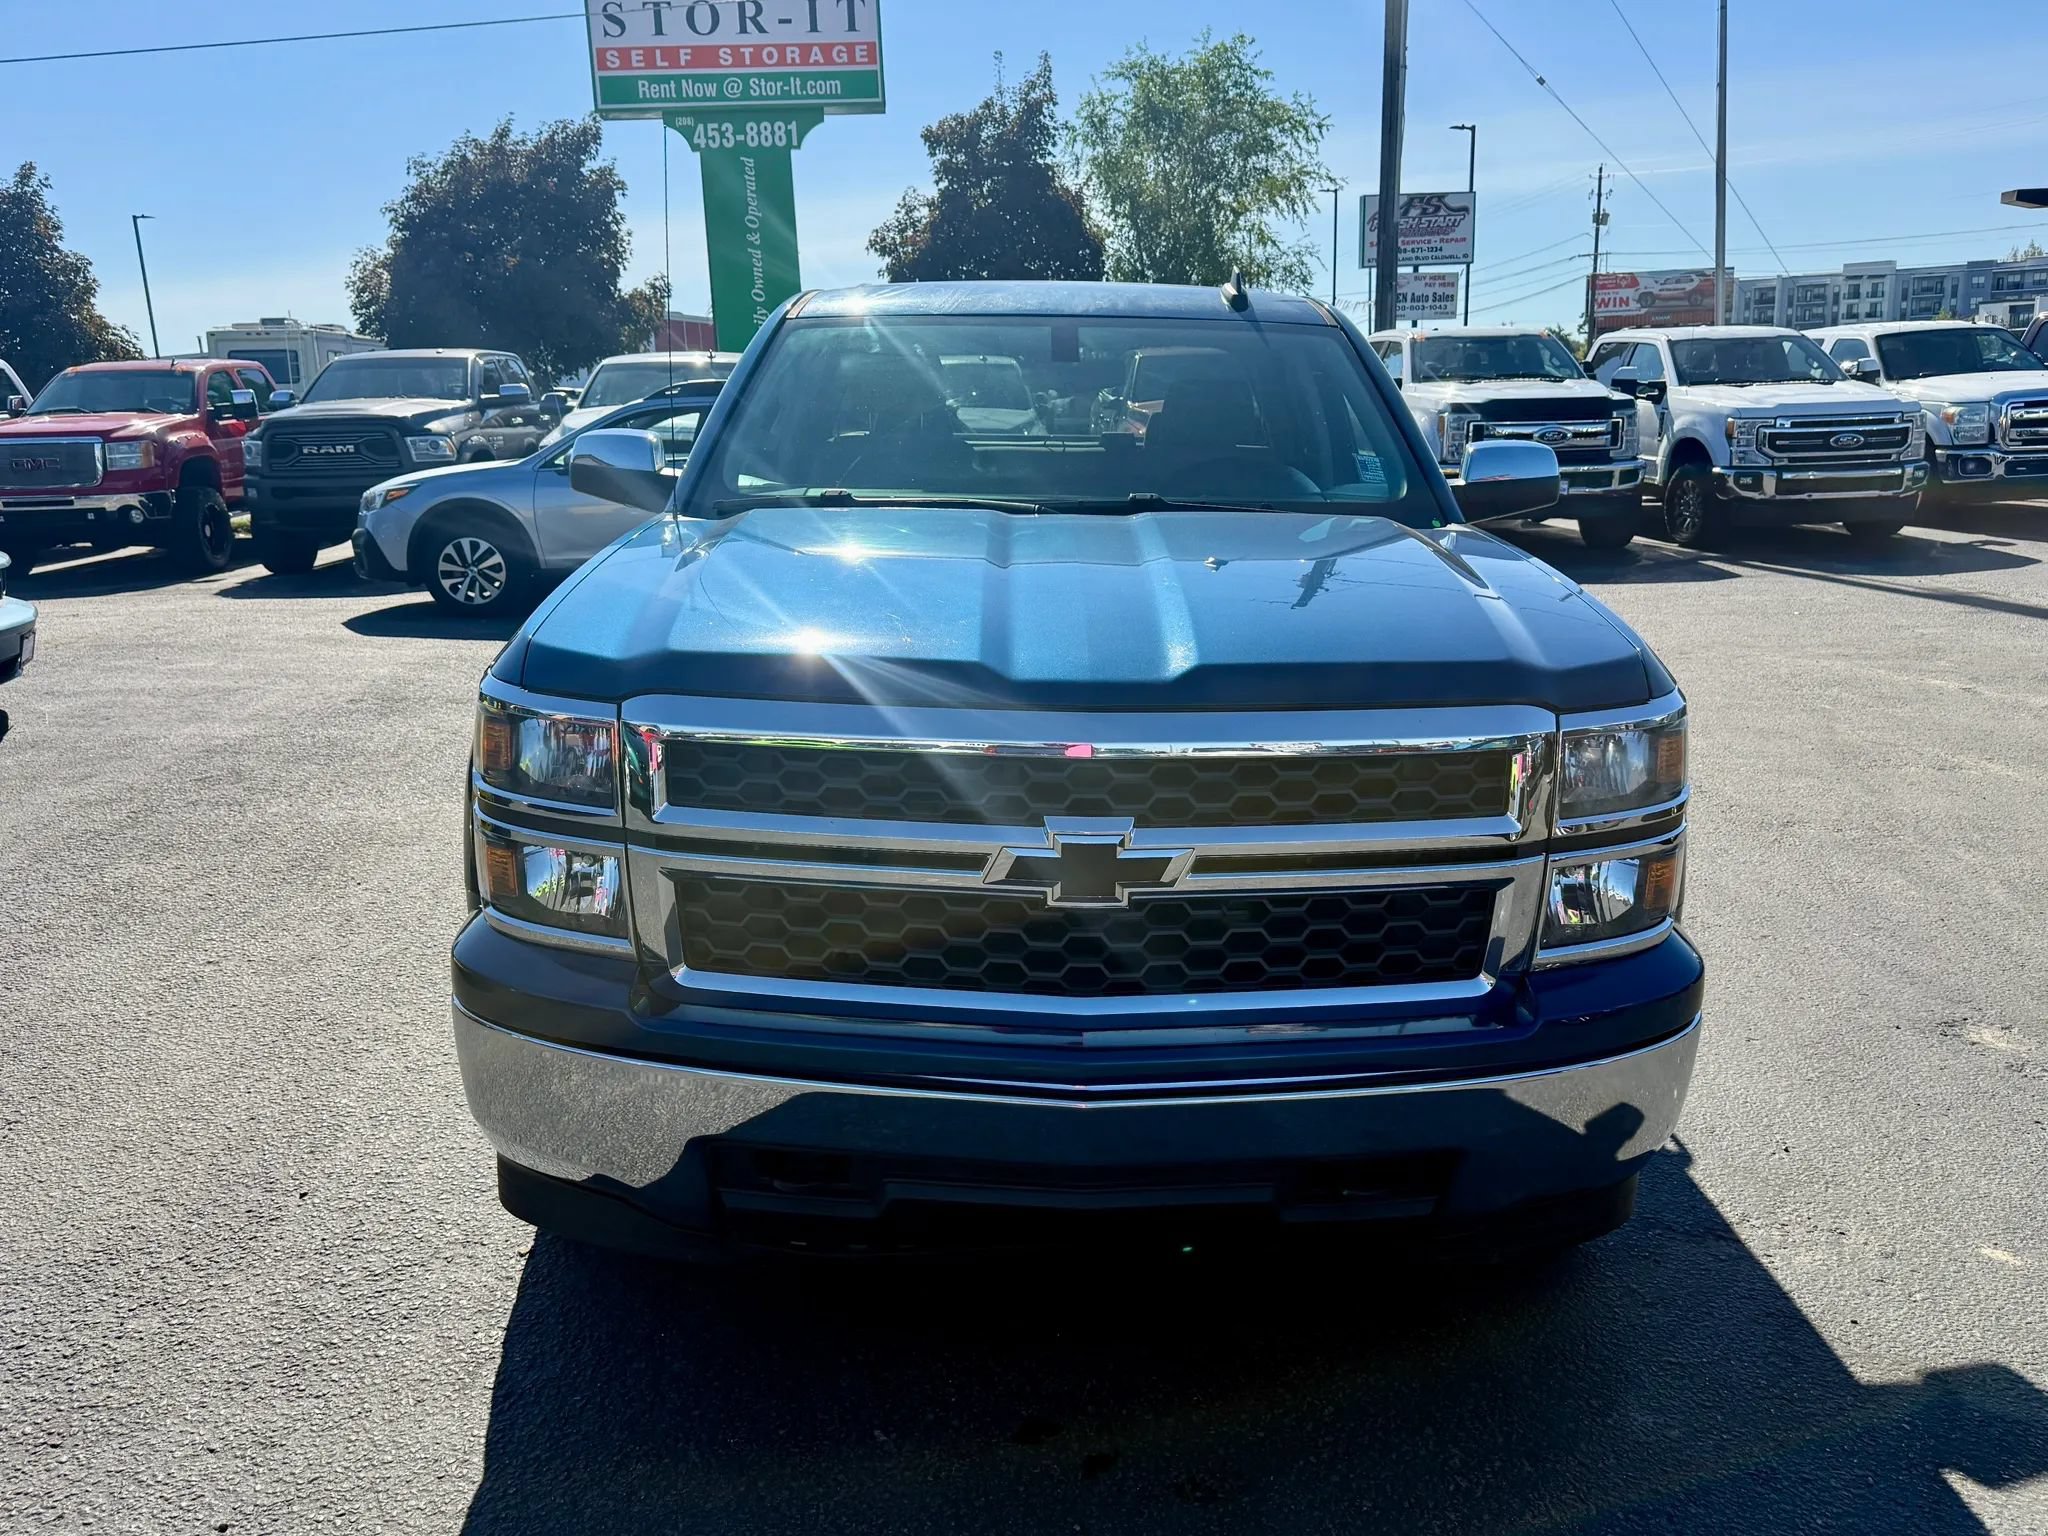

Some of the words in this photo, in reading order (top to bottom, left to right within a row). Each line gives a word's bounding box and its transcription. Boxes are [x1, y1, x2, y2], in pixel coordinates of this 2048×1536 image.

[601, 0, 866, 38] STOR-IT
[606, 49, 692, 68] SELF
[719, 45, 869, 64] STORAGE
[638, 80, 677, 98] Rent
[681, 79, 717, 97] Now
[723, 77, 743, 98] @
[749, 76, 841, 97] Stor-It.com
[693, 121, 798, 149] 453-8881
[740, 156, 762, 229] Operated
[746, 231, 761, 245] &
[751, 248, 766, 302] Owned
[1410, 292, 1430, 304] Auto
[1431, 291, 1455, 303] Sales
[1596, 296, 1630, 309] WIN
[302, 445, 355, 454] RAM
